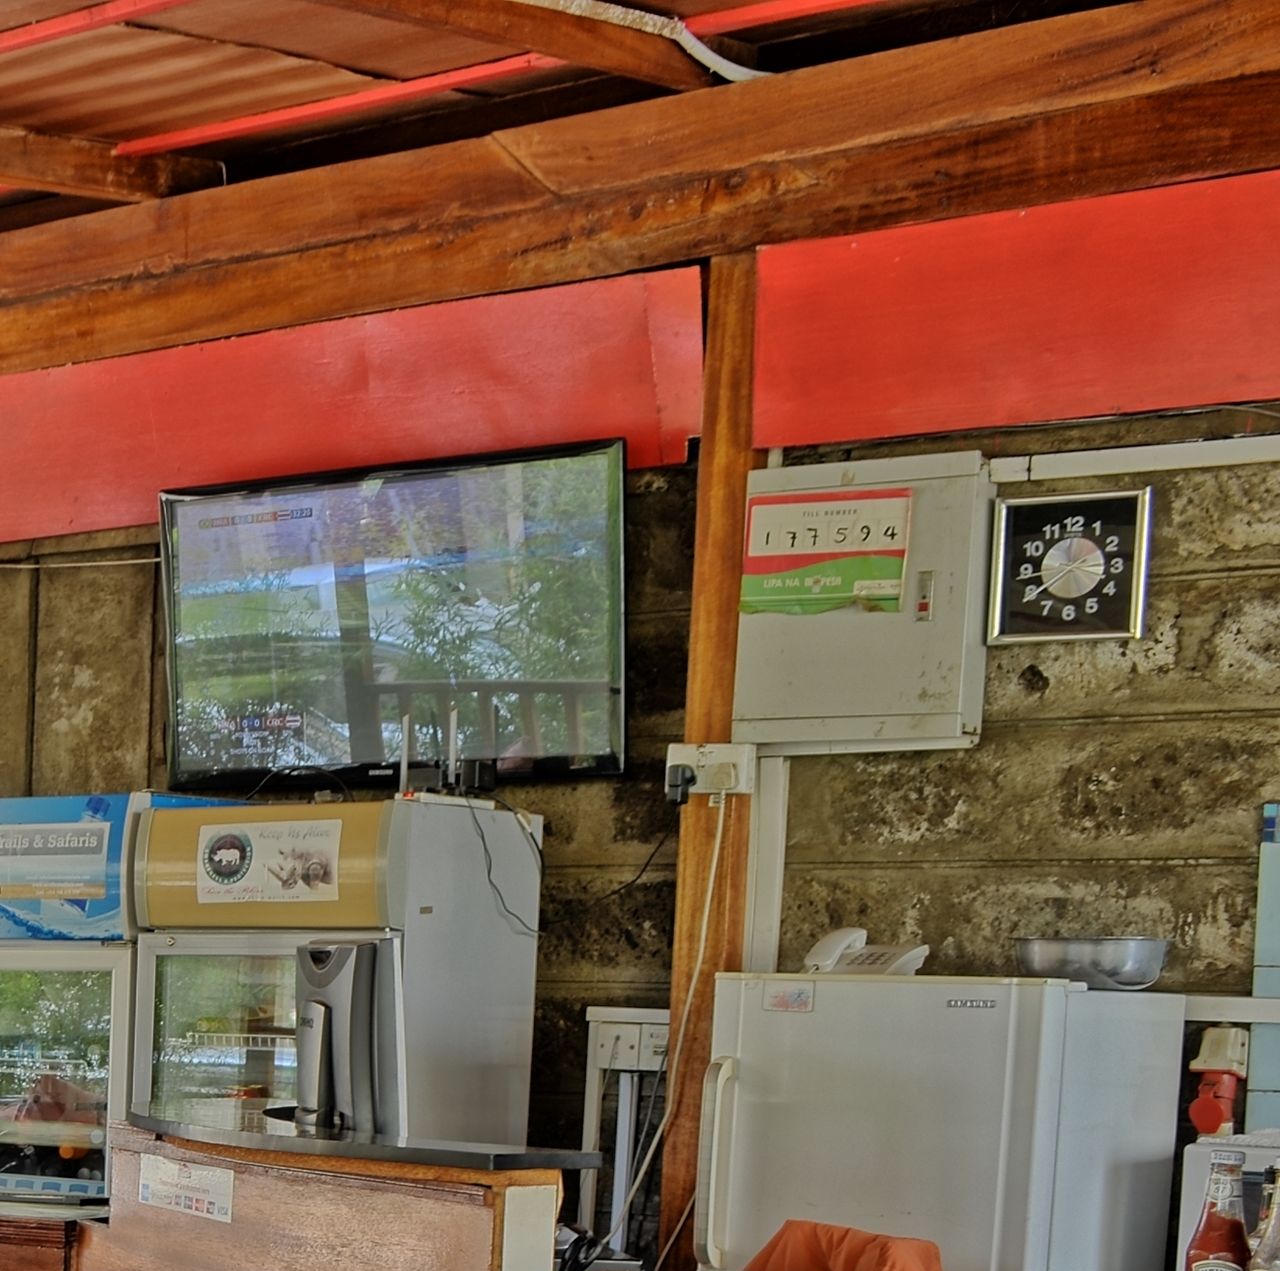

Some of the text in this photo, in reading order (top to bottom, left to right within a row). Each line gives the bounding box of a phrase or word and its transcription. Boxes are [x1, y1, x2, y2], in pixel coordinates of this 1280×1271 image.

[803, 508, 858, 518] TILL NUMBER
[1042, 523, 1060, 539] 11
[1063, 515, 1085, 532] 12
[1092, 520, 1102, 536] 1
[1023, 541, 1044, 557] 10
[1105, 535, 1119, 552] 2
[1019, 563, 1033, 578] 9
[1109, 557, 1124, 574] 3
[763, 579, 783, 588] LIPA
[785, 578, 800, 587] NA
[1102, 580, 1117, 596] 4
[1040, 600, 1053, 616] 7
[1061, 604, 1076, 620] 6
[1084, 597, 1098, 613] 5
[33, 835, 44, 848] &
[47, 832, 98, 848] Safaris
[946, 999, 996, 1009] SAMSUNG
